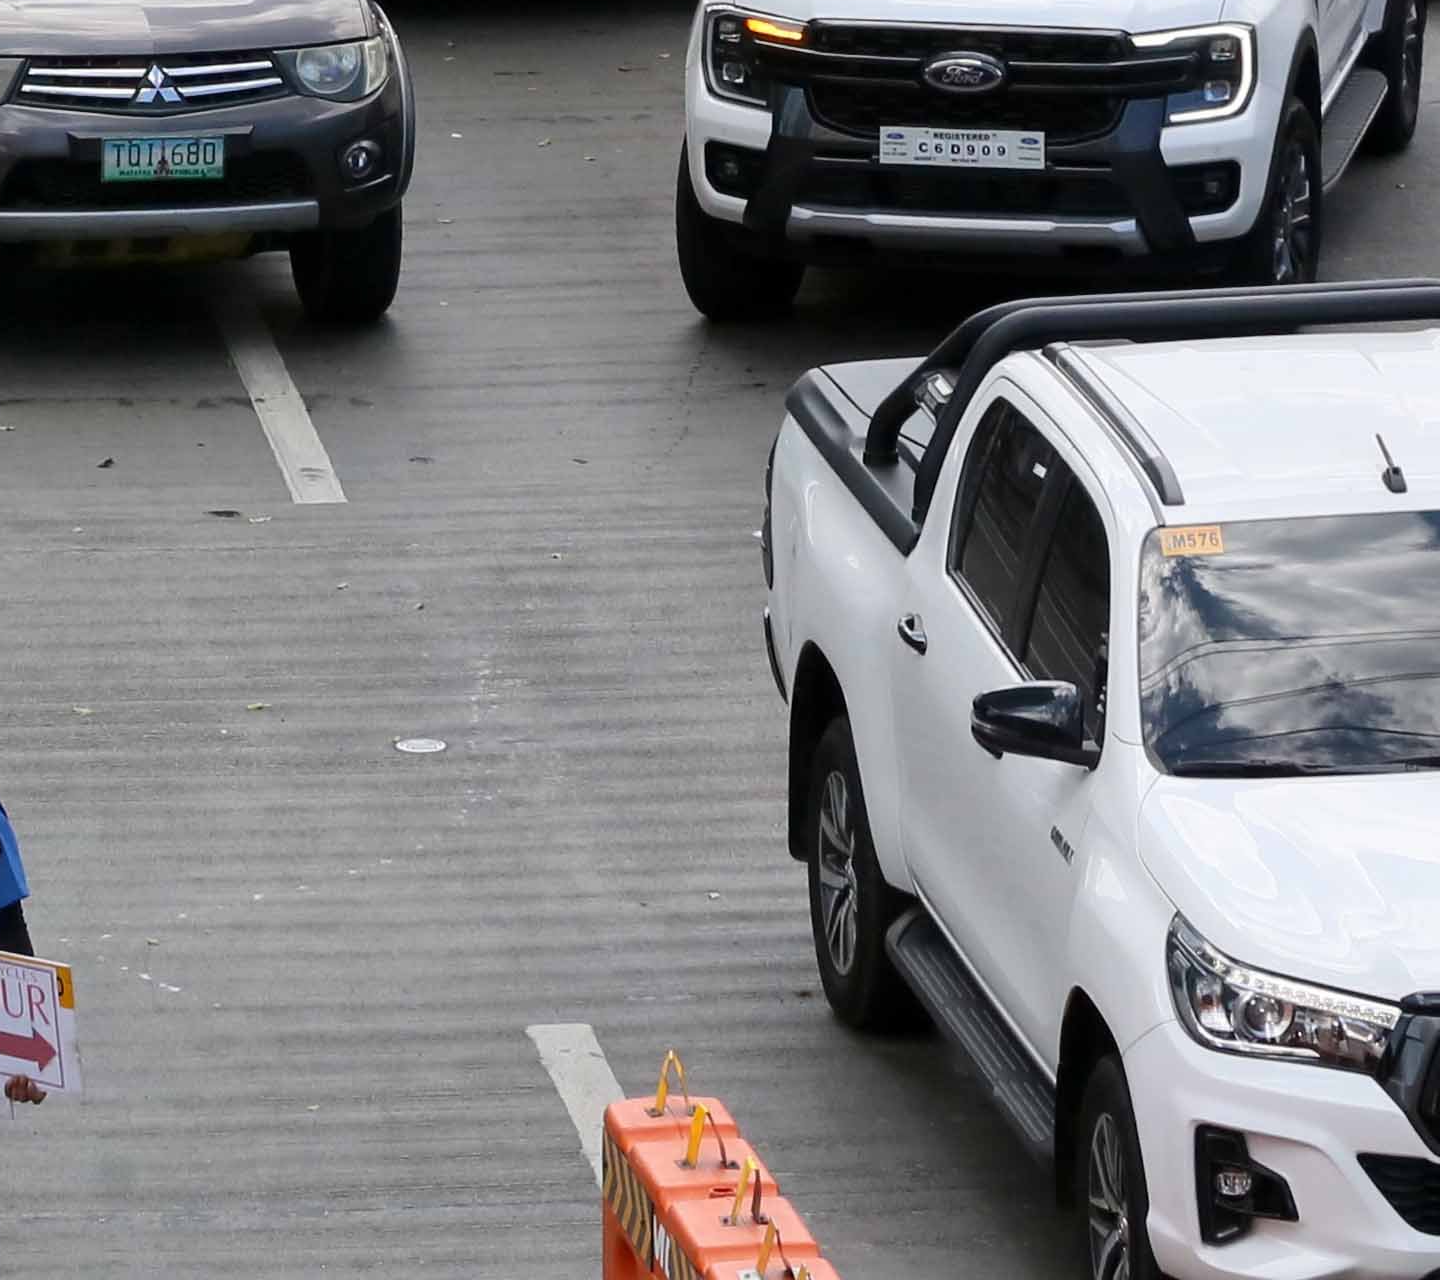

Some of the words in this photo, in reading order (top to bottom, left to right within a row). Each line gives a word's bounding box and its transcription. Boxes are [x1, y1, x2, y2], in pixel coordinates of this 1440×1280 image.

[942, 65, 984, 84] Ford
[933, 132, 991, 141] REGISTERED
[171, 141, 216, 166] 680
